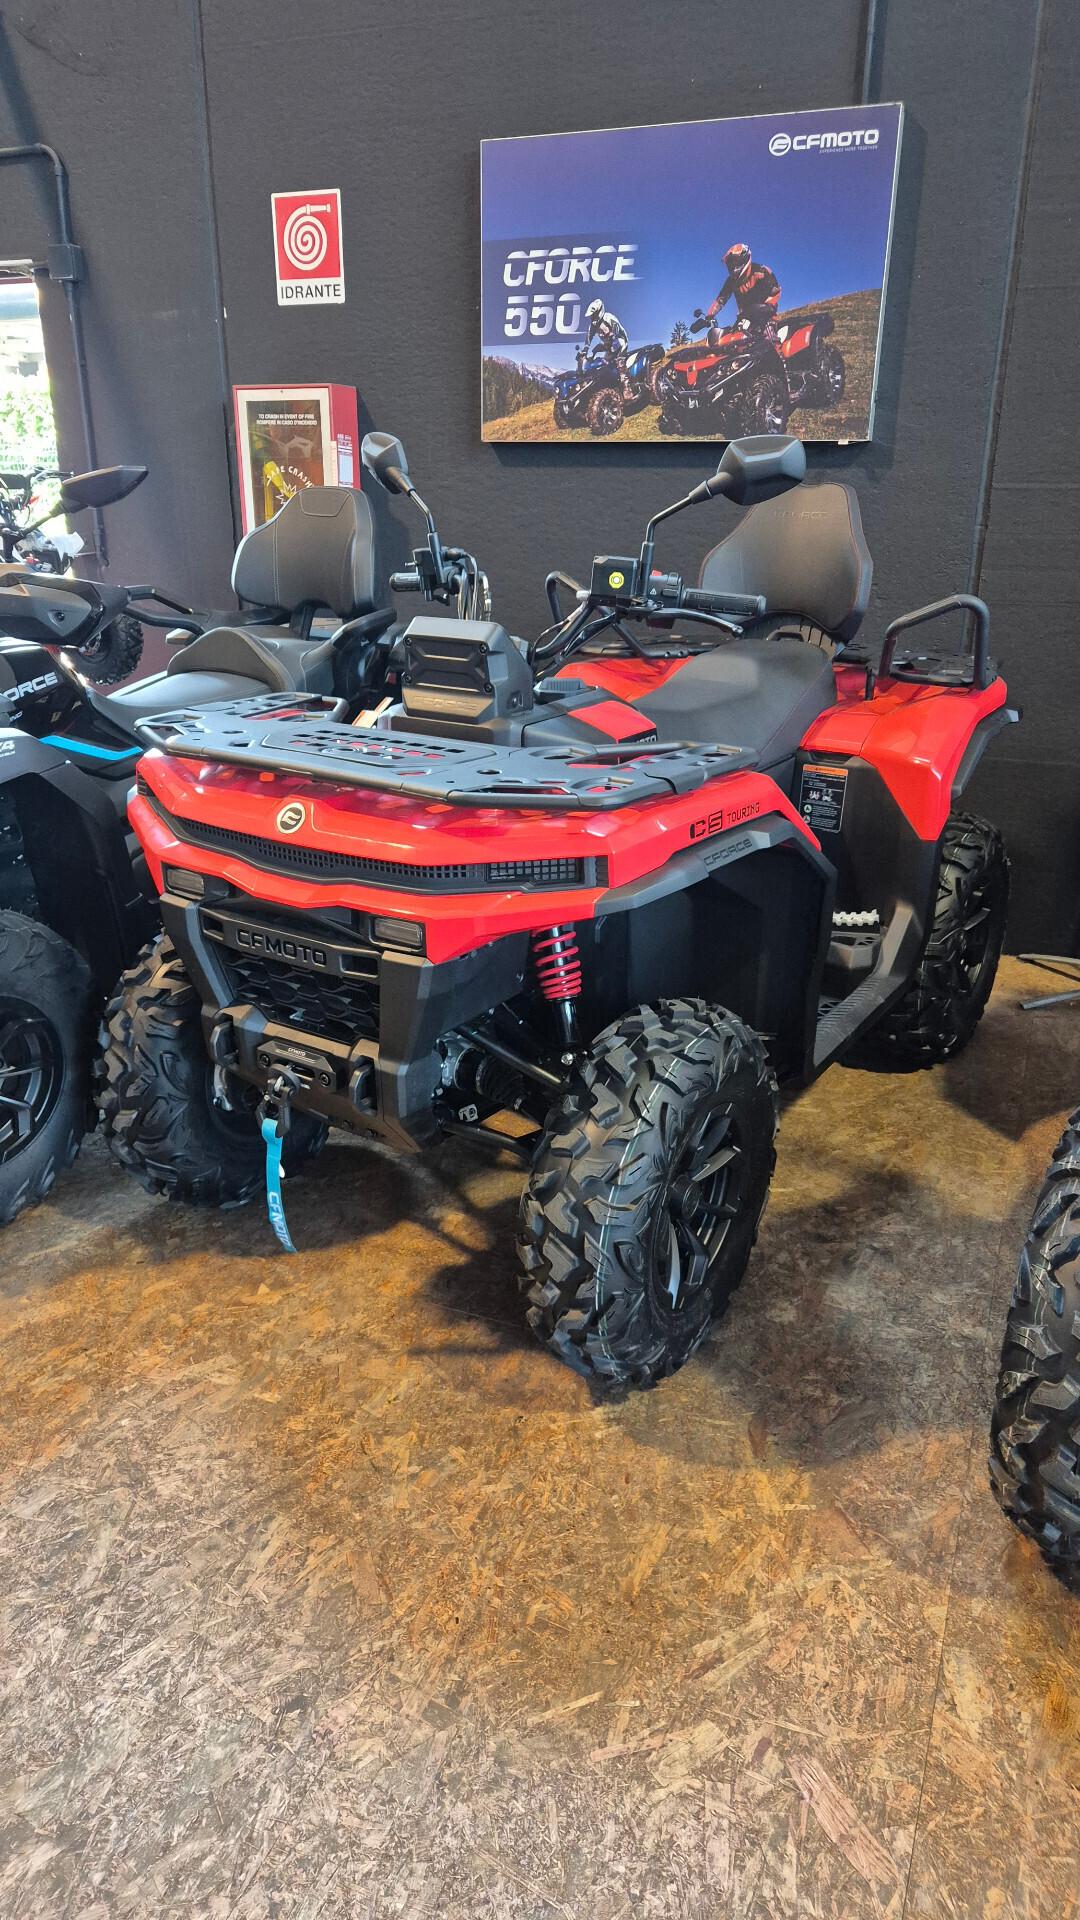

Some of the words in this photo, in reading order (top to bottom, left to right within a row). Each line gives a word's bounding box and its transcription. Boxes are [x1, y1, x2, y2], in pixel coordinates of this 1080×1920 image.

[792, 129, 880, 150] CFMOTO
[502, 243, 642, 287] CFORCE
[280, 284, 342, 300] IDRANTE
[504, 292, 583, 338] 550
[1, 671, 59, 701] ORCE
[726, 802, 760, 823] TOURING
[703, 838, 753, 866] CFORCE
[236, 928, 327, 967] CFMOTO
